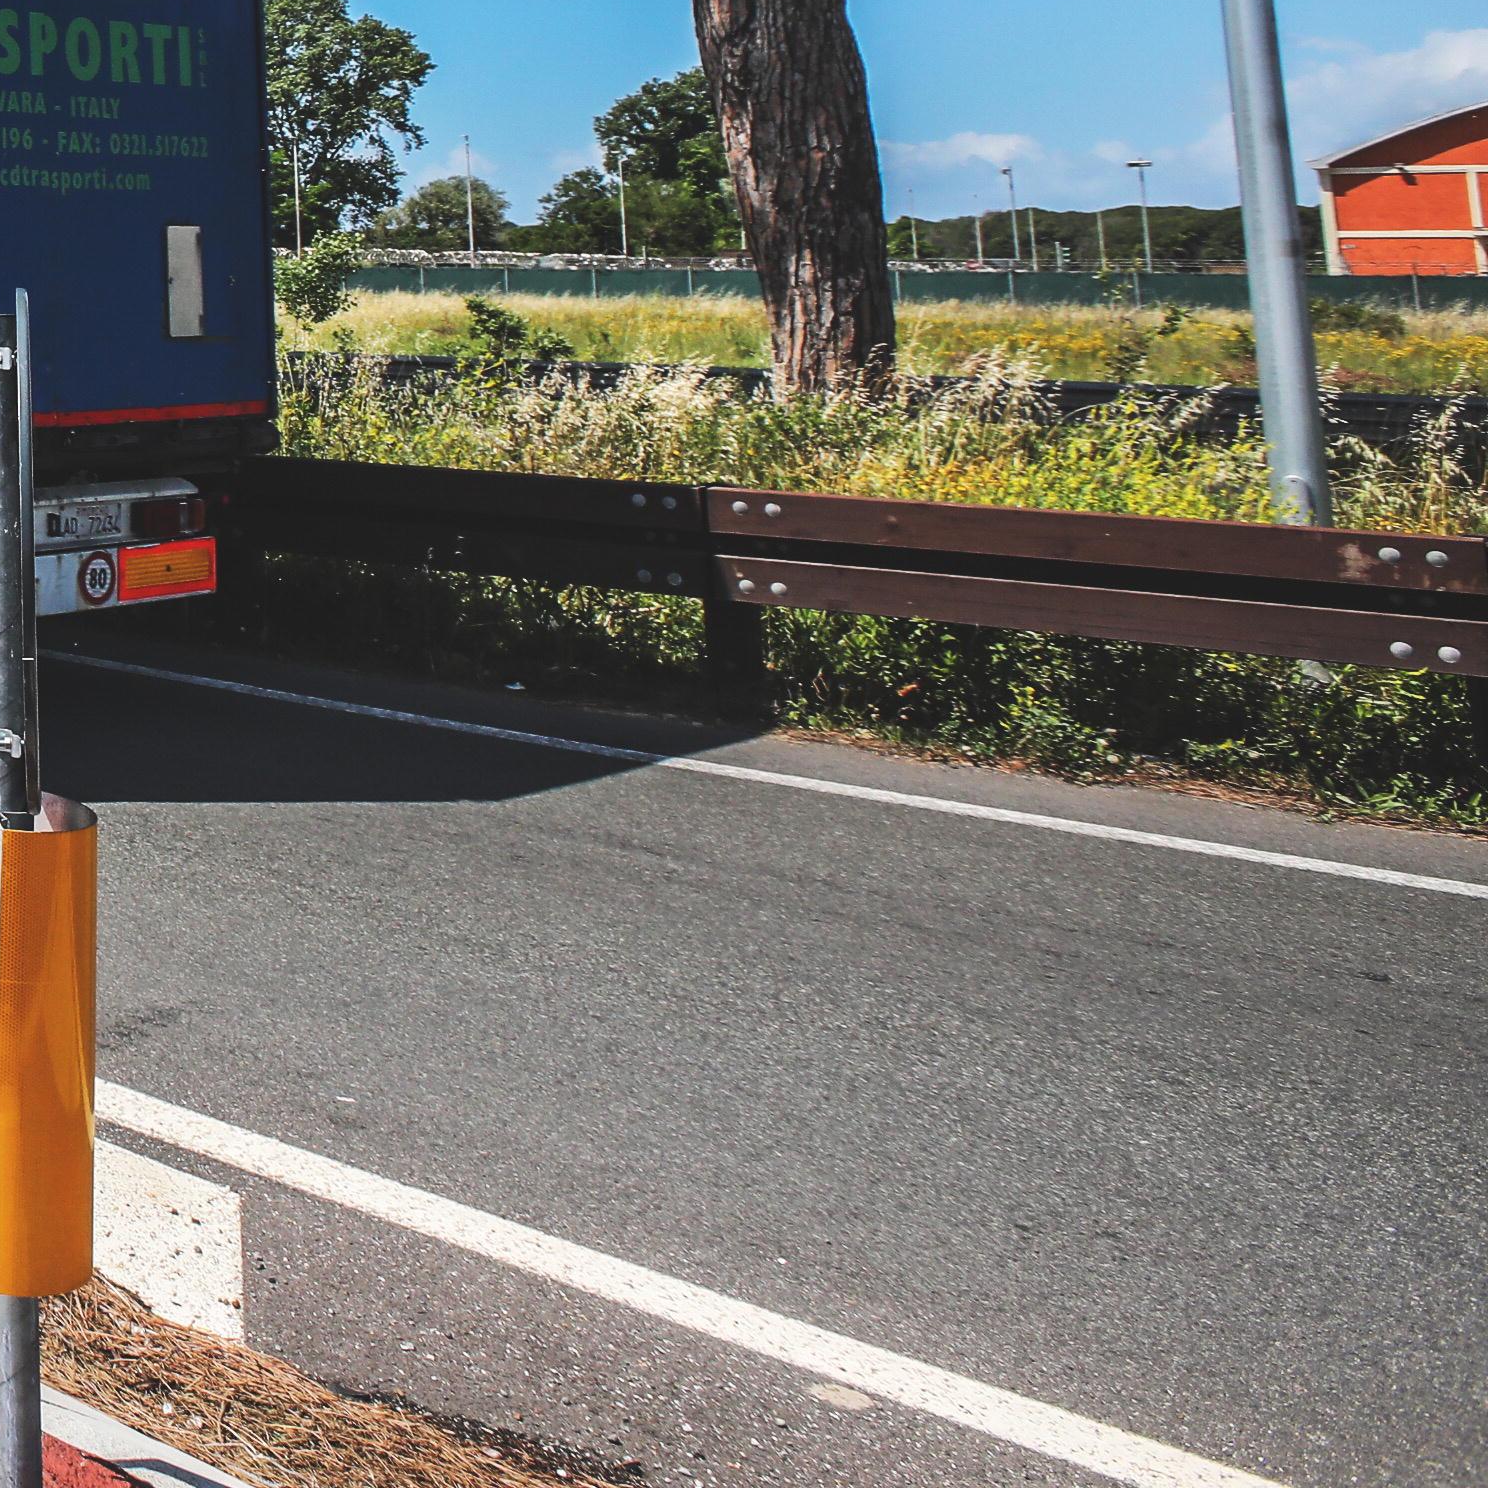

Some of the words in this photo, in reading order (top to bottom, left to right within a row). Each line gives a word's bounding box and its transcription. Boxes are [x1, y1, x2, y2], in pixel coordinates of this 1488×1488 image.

[70, 95, 120, 119] ITALY
[57, 130, 101, 155] FAX:
[109, 134, 209, 159] 0321.517622
[89, 567, 108, 589] 80
